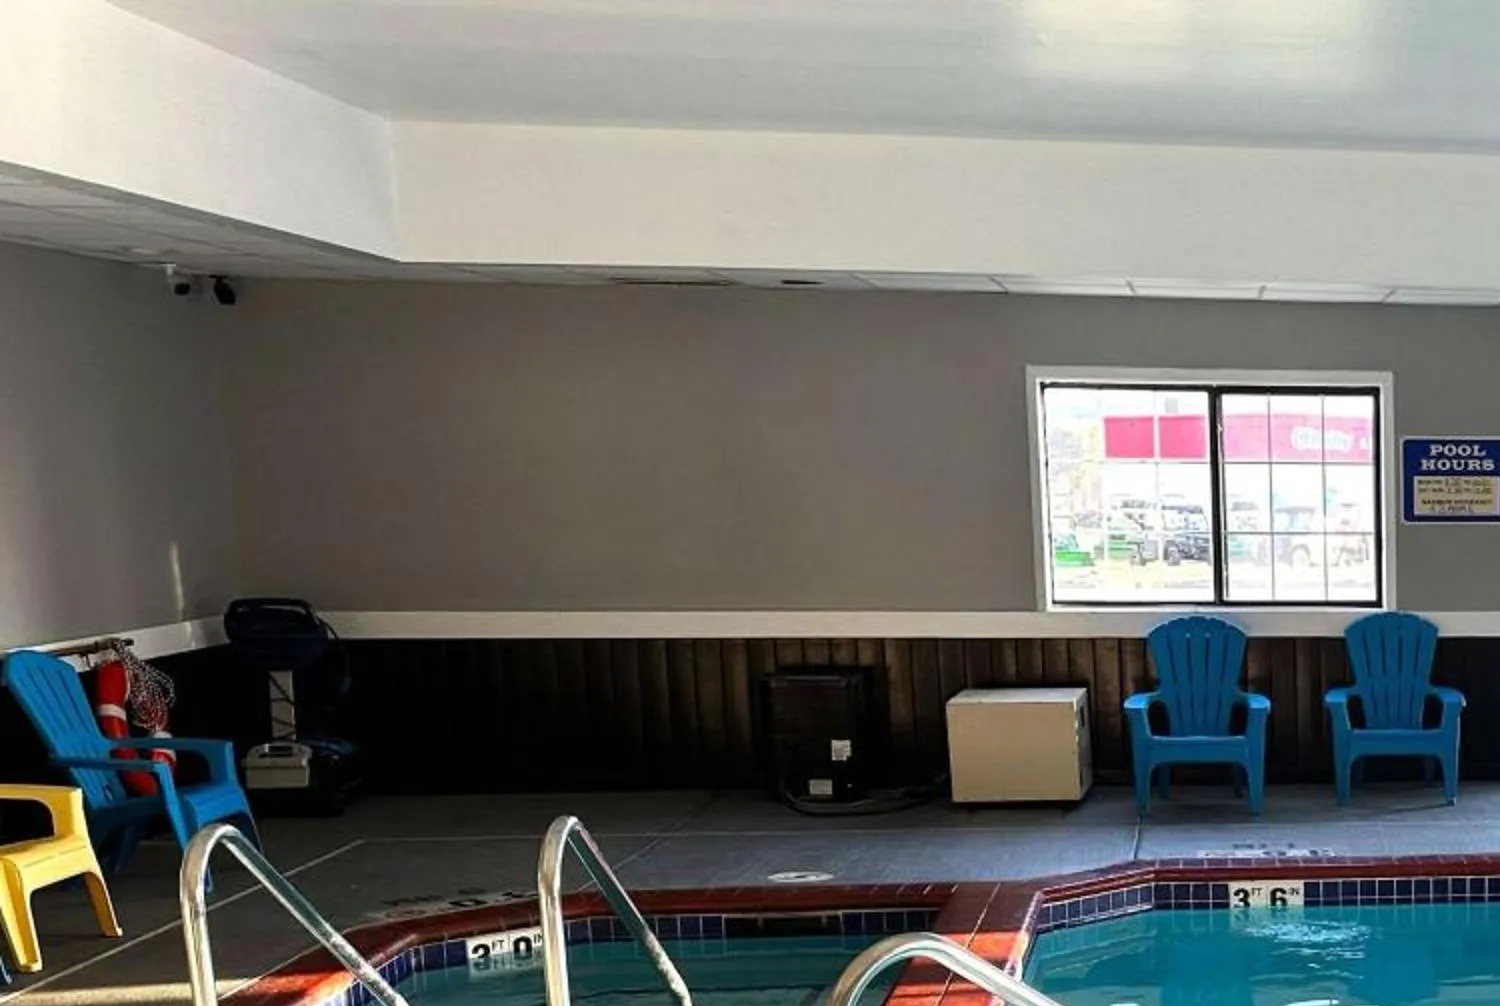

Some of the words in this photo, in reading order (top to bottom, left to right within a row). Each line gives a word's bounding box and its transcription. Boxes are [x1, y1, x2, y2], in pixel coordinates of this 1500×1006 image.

[1429, 444, 1487, 457] POOL
[1421, 459, 1495, 471] HOURS
[1233, 888, 1250, 908] 3
[1270, 887, 1288, 908] 6
